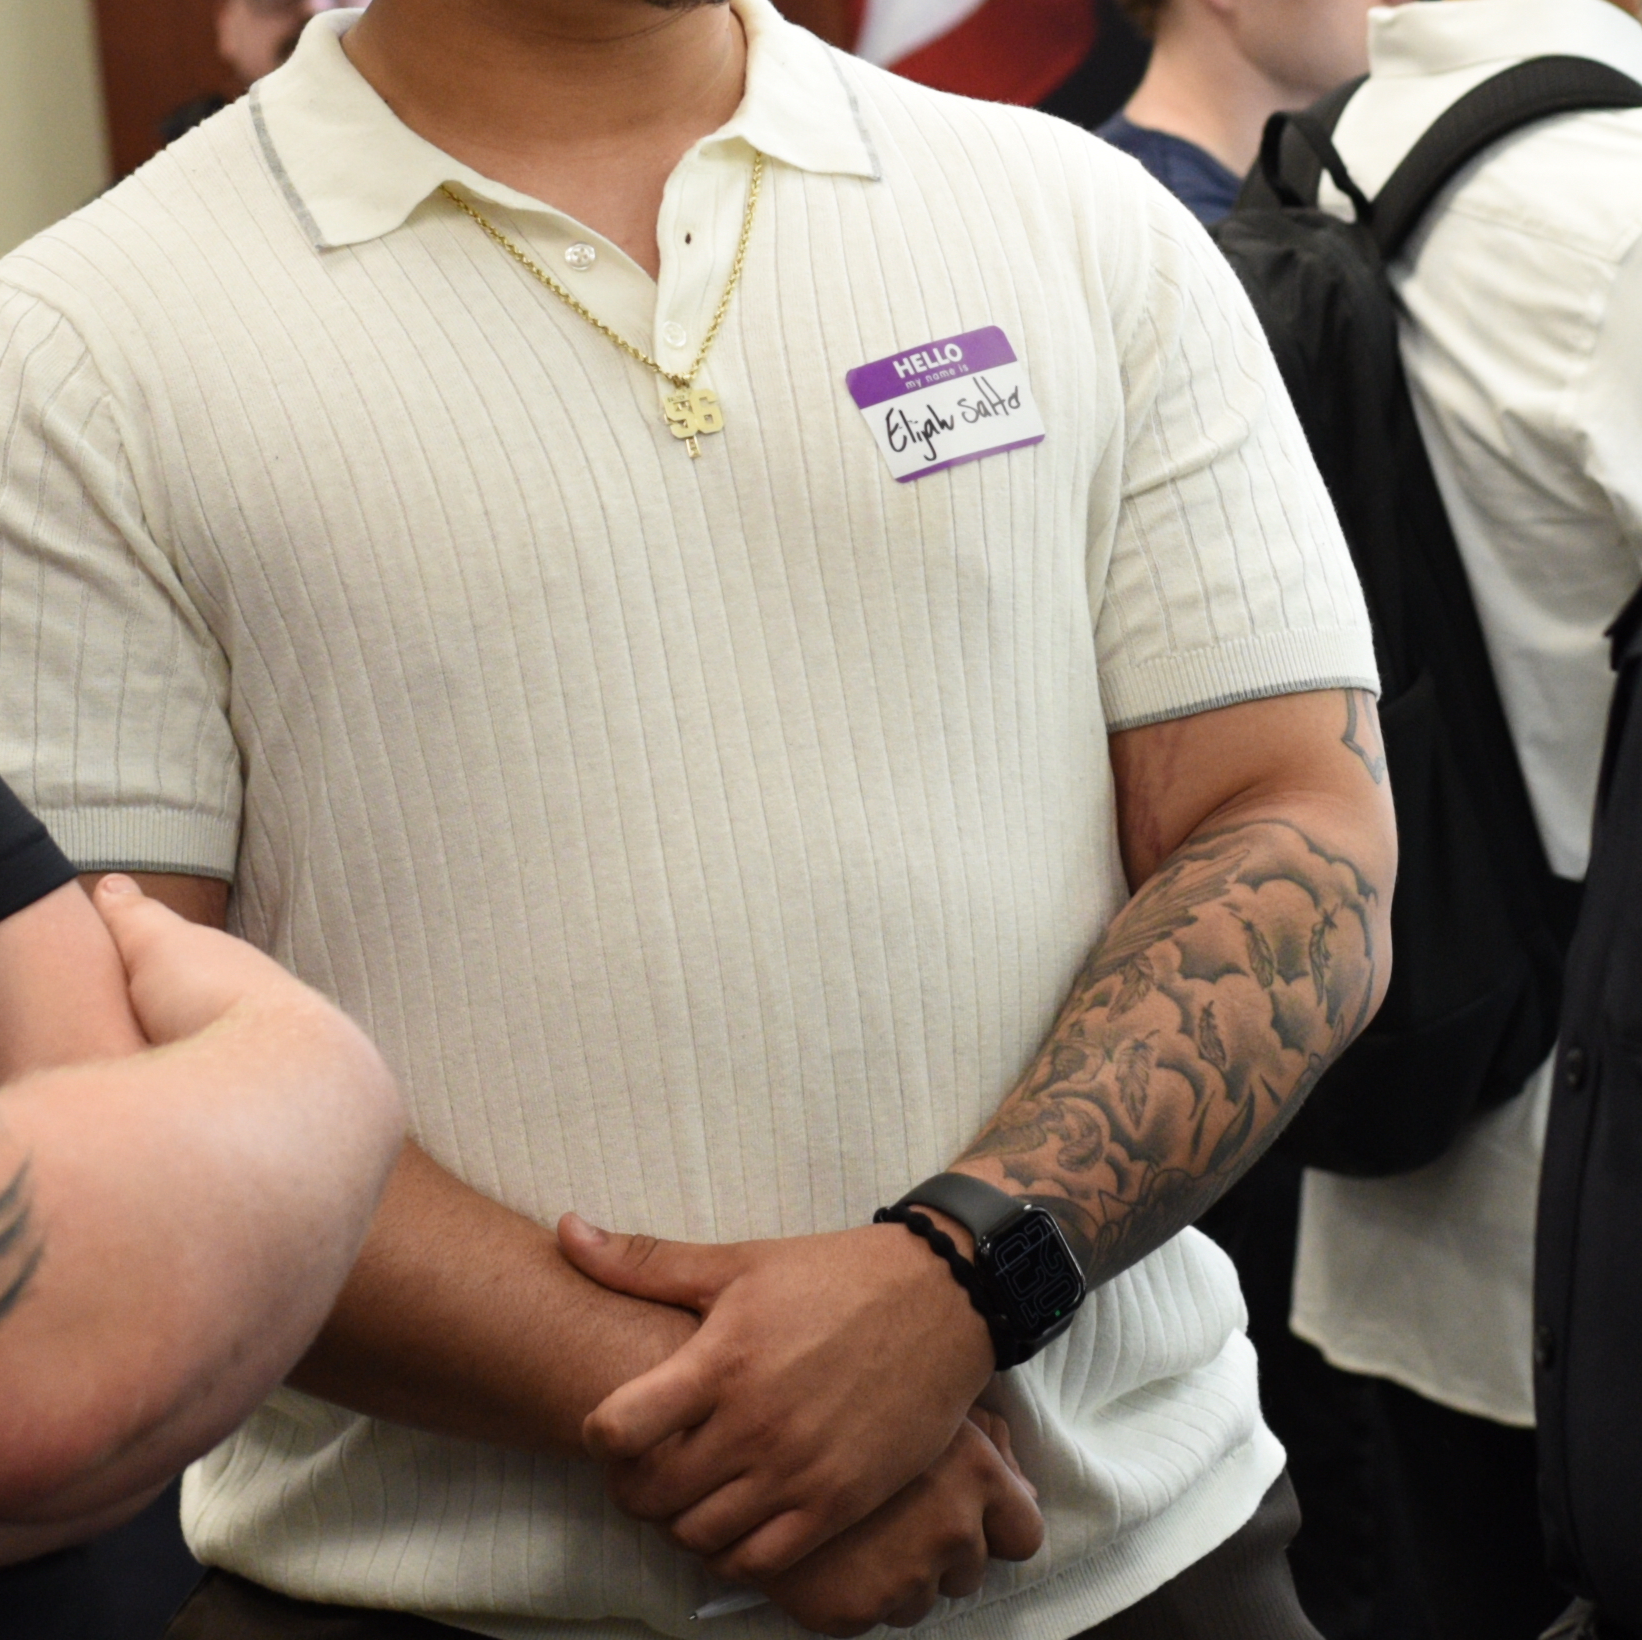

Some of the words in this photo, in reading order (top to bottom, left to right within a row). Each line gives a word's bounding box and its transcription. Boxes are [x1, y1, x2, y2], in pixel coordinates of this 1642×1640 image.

[892, 343, 963, 379] HELLO
[905, 377, 922, 391] my
[925, 367, 956, 383] name
[959, 363, 969, 376] is
[664, 388, 724, 439] 56
[885, 404, 955, 462] Elijah
